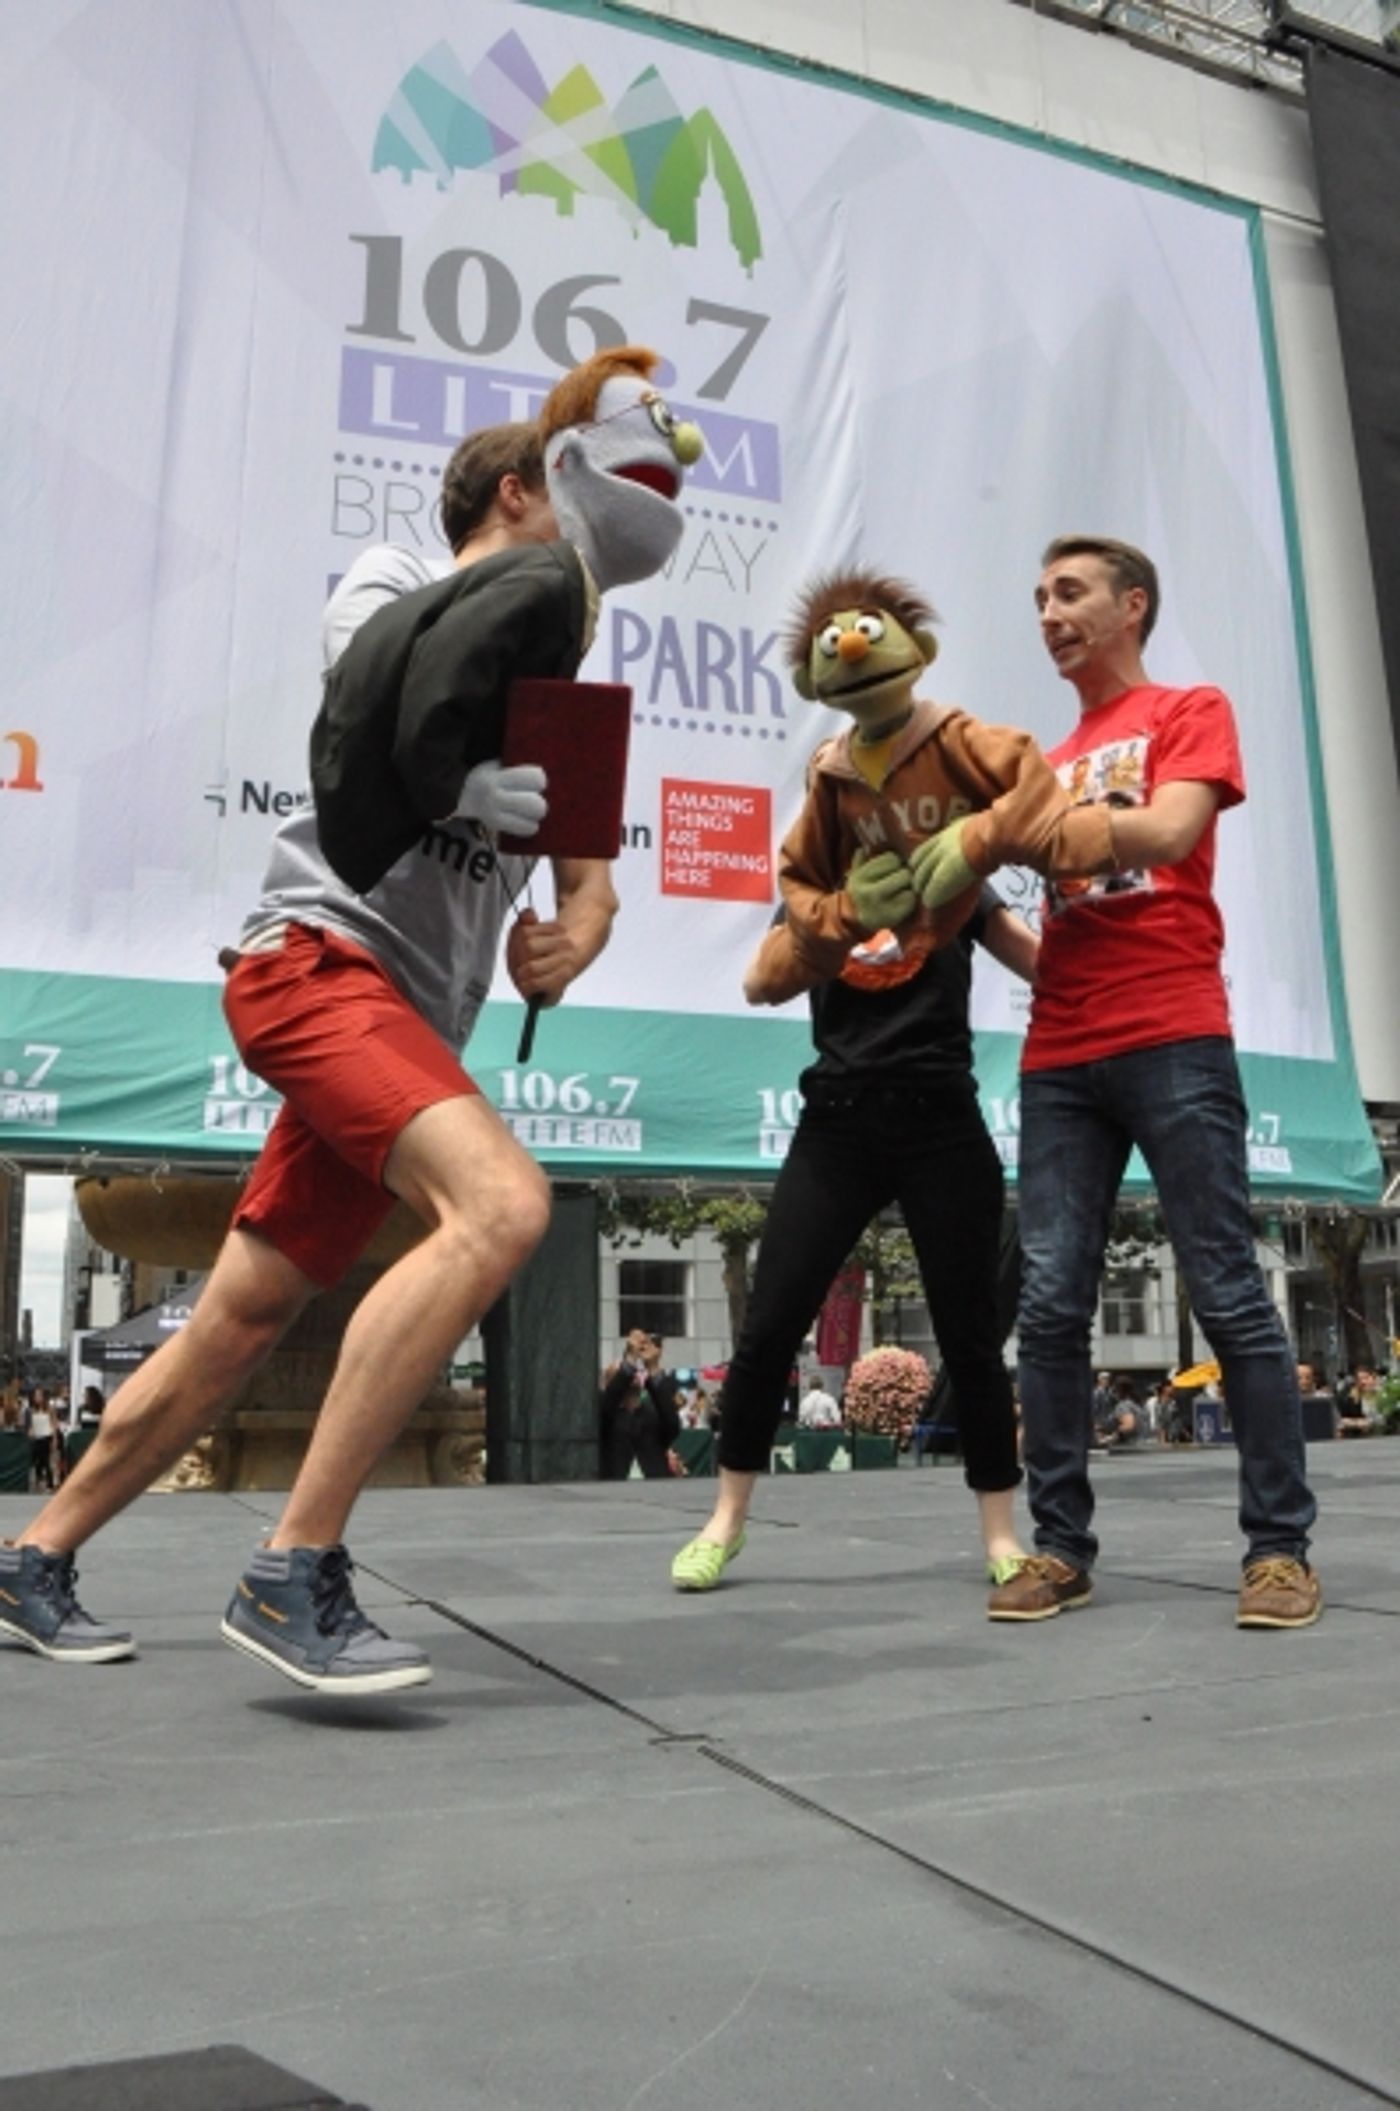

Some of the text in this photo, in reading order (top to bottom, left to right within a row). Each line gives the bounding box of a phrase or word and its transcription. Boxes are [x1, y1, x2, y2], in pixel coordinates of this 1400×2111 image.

[611, 607, 786, 719] PARK
[666, 791, 755, 815] AMAZING
[666, 809, 734, 832] THINGS
[665, 829, 701, 847] ARE
[665, 847, 769, 874] HAPPENING
[665, 867, 712, 888] HERE
[498, 1069, 640, 1115] 106.7
[594, 1120, 636, 1148] FM
